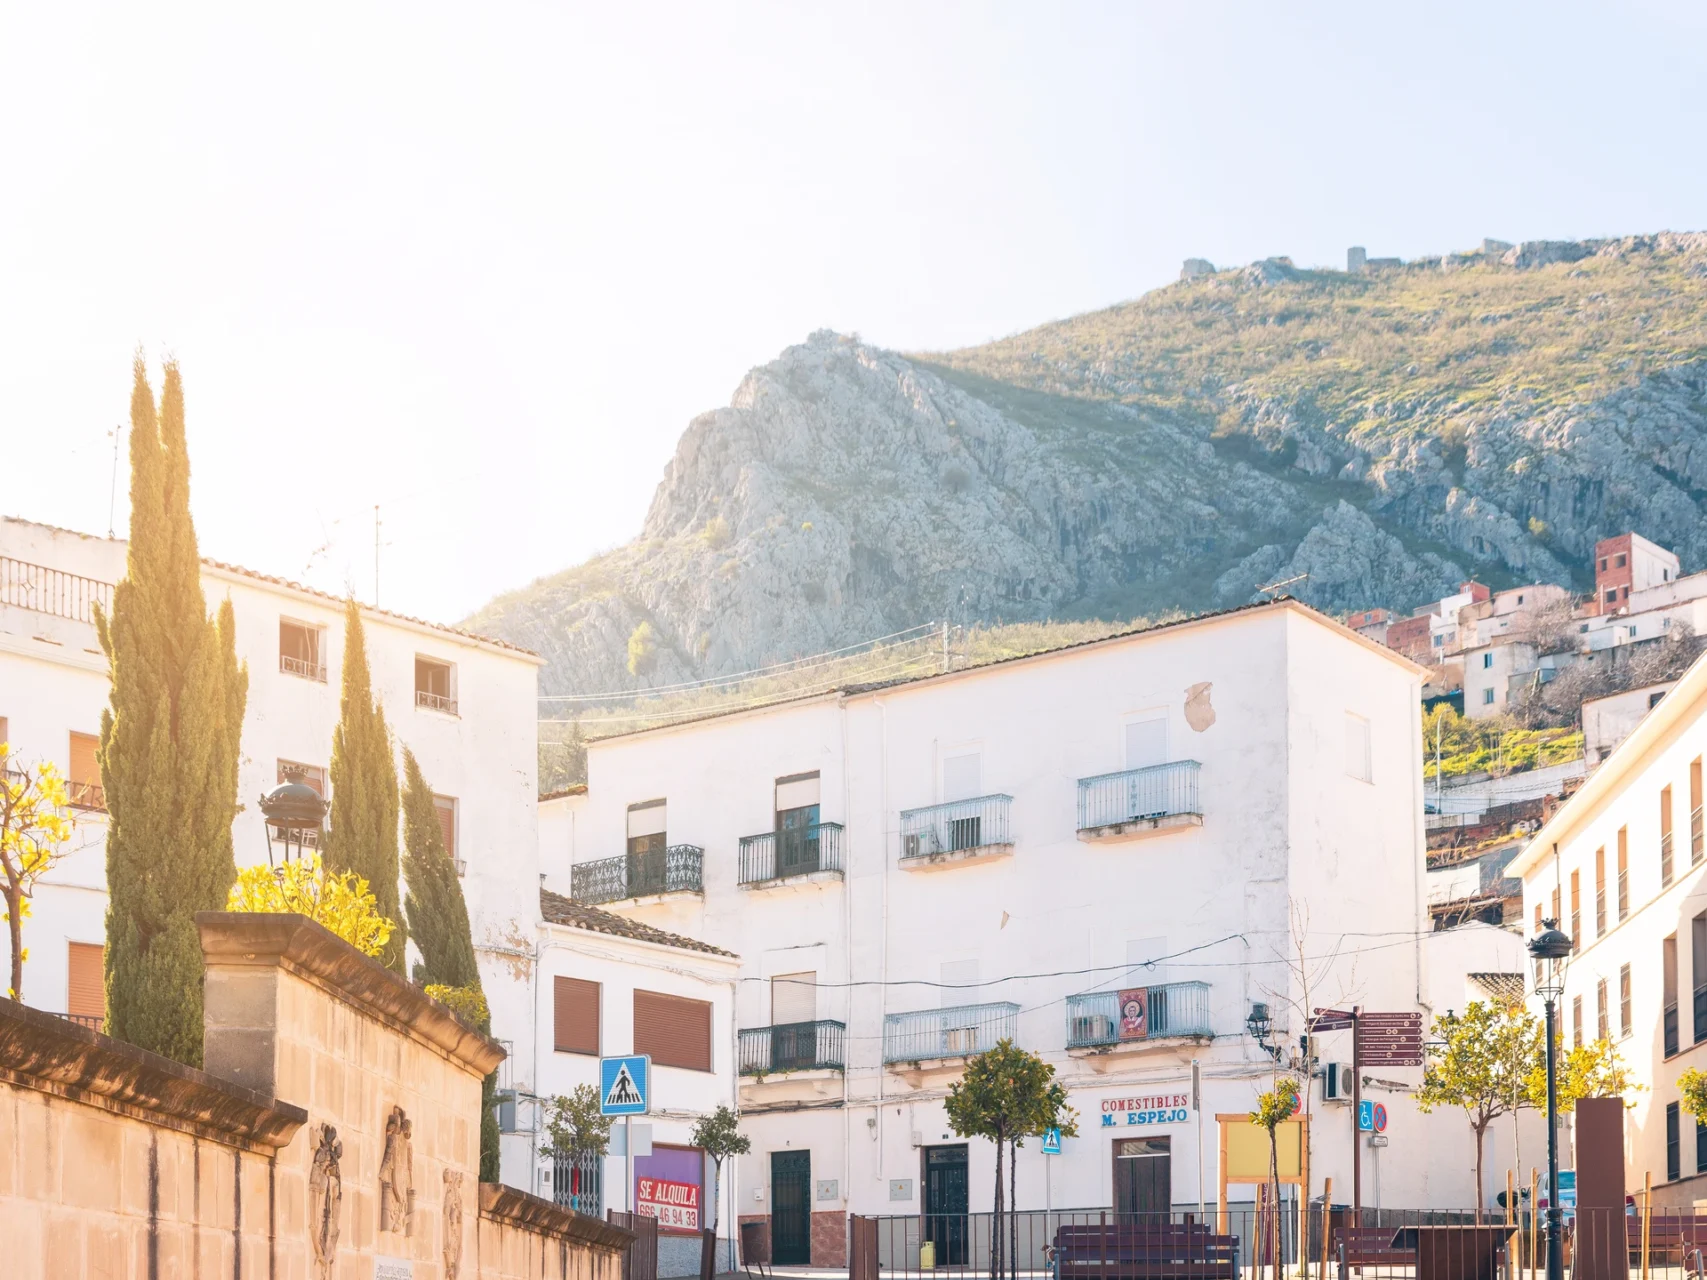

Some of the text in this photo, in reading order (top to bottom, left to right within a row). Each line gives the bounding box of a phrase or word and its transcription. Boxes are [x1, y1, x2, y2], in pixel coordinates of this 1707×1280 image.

[1102, 1095, 1188, 1112] COMESTIBLES
[1102, 1109, 1187, 1126] M. ESPEJO
[640, 1180, 697, 1206] SE ALQUILA
[659, 1207, 670, 1223] 46
[672, 1209, 683, 1225] 94
[686, 1210, 697, 1226] 33
